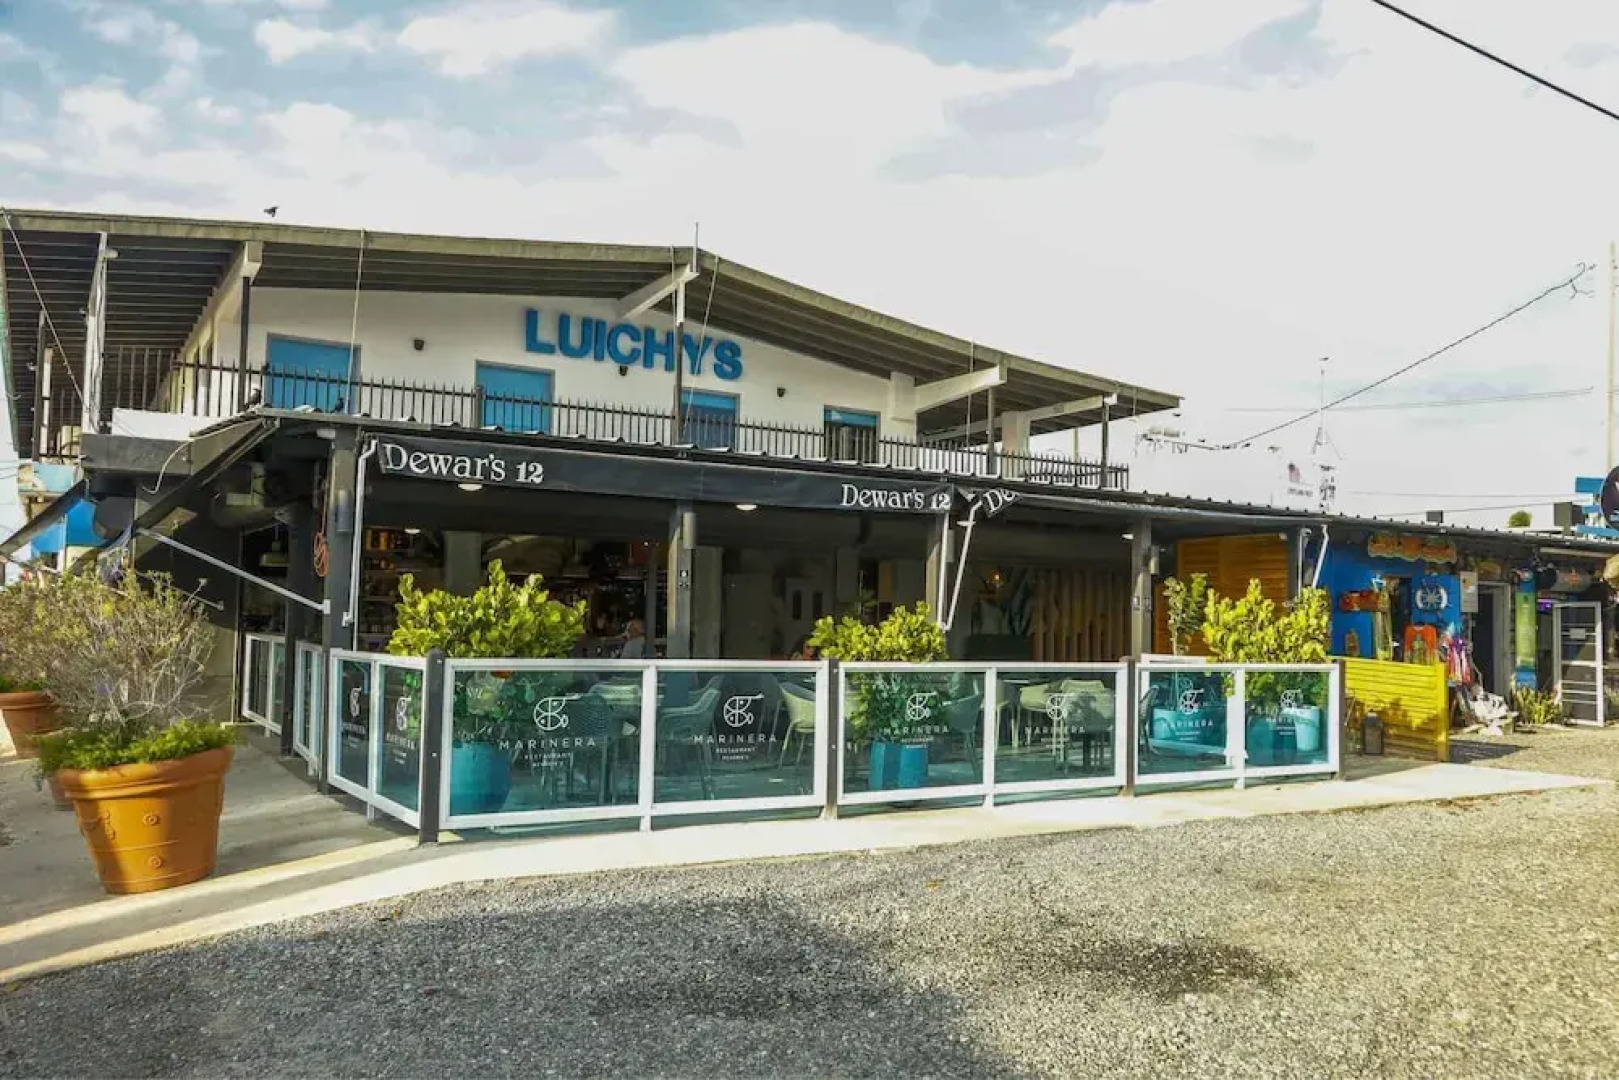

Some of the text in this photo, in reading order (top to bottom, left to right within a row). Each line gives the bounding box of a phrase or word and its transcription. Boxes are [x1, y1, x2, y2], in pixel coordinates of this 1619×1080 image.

[525, 307, 744, 381] LUICHYS
[382, 442, 545, 485] Dewar's 12
[840, 483, 951, 510] Dewar's 12
[498, 737, 597, 751] MARINERA
[693, 732, 778, 744] MARINERA
